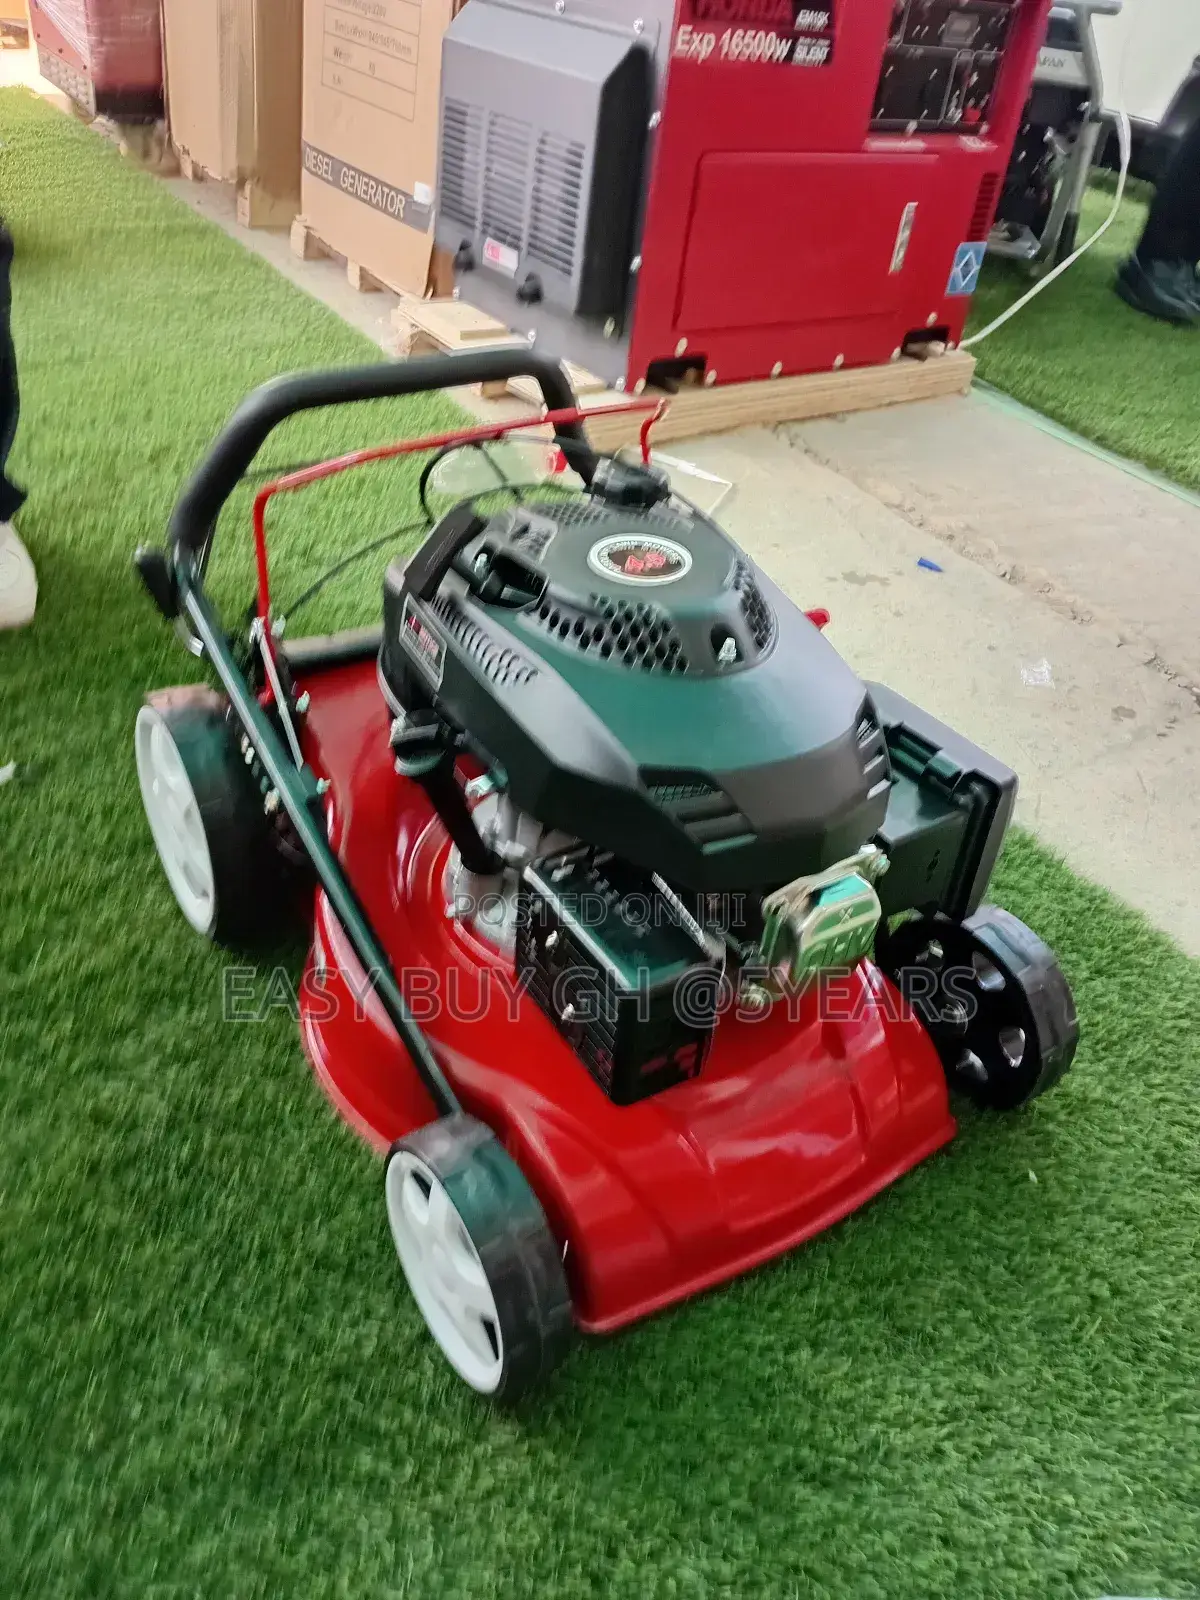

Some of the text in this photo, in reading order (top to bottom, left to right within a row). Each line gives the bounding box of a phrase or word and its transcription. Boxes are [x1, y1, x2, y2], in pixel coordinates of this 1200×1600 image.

[672, 24, 792, 64] Exp 16500w
[305, 146, 405, 219] DIESEL GENERATOR
